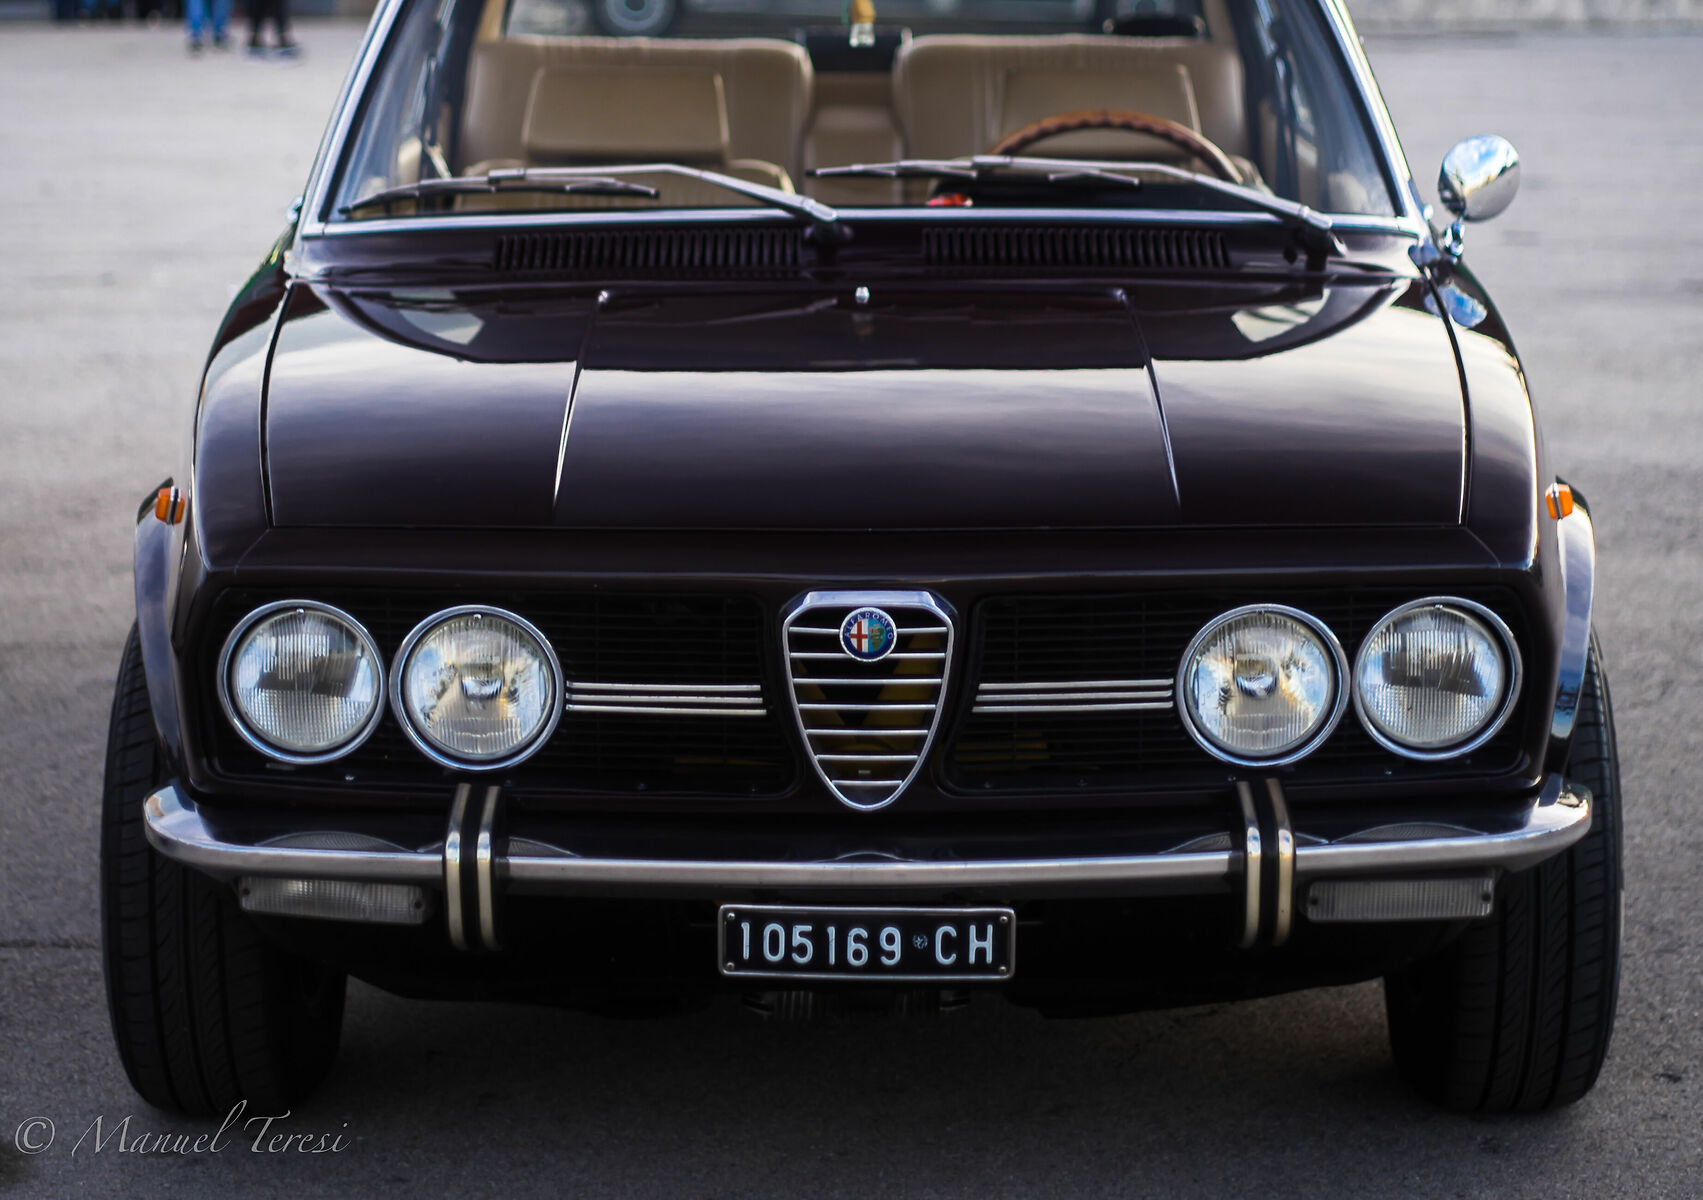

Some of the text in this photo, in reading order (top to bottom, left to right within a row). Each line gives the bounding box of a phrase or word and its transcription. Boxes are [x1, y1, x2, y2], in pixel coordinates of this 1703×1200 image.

[844, 611, 894, 640] ALFA ROMEO
[740, 921, 994, 967] 105169 CH
